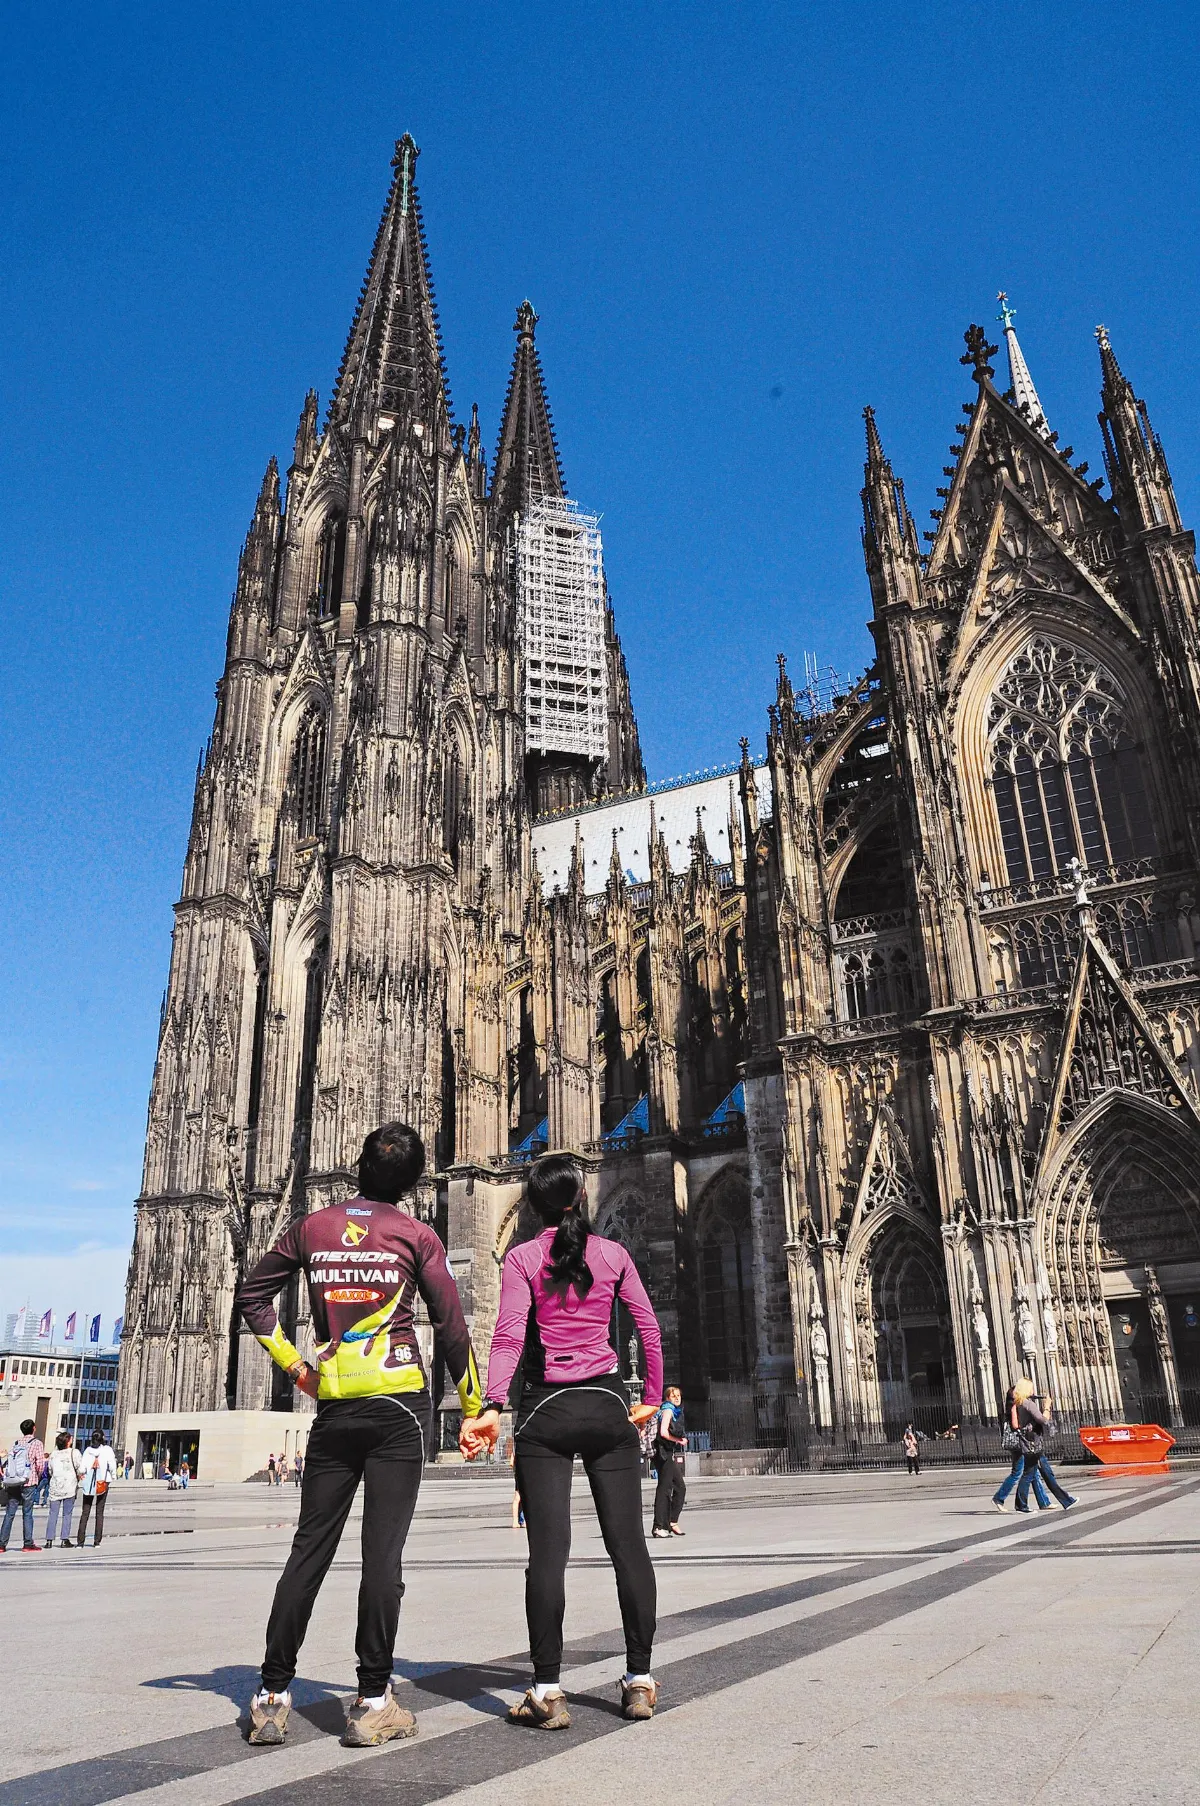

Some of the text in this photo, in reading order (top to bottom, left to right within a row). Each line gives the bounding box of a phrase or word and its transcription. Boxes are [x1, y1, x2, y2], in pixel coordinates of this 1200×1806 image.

[310, 1251, 399, 1263] MERIDA
[310, 1269, 399, 1283] MULTIVAN
[329, 1290, 373, 1300] MAXXIS
[394, 1346, 412, 1361] 96
